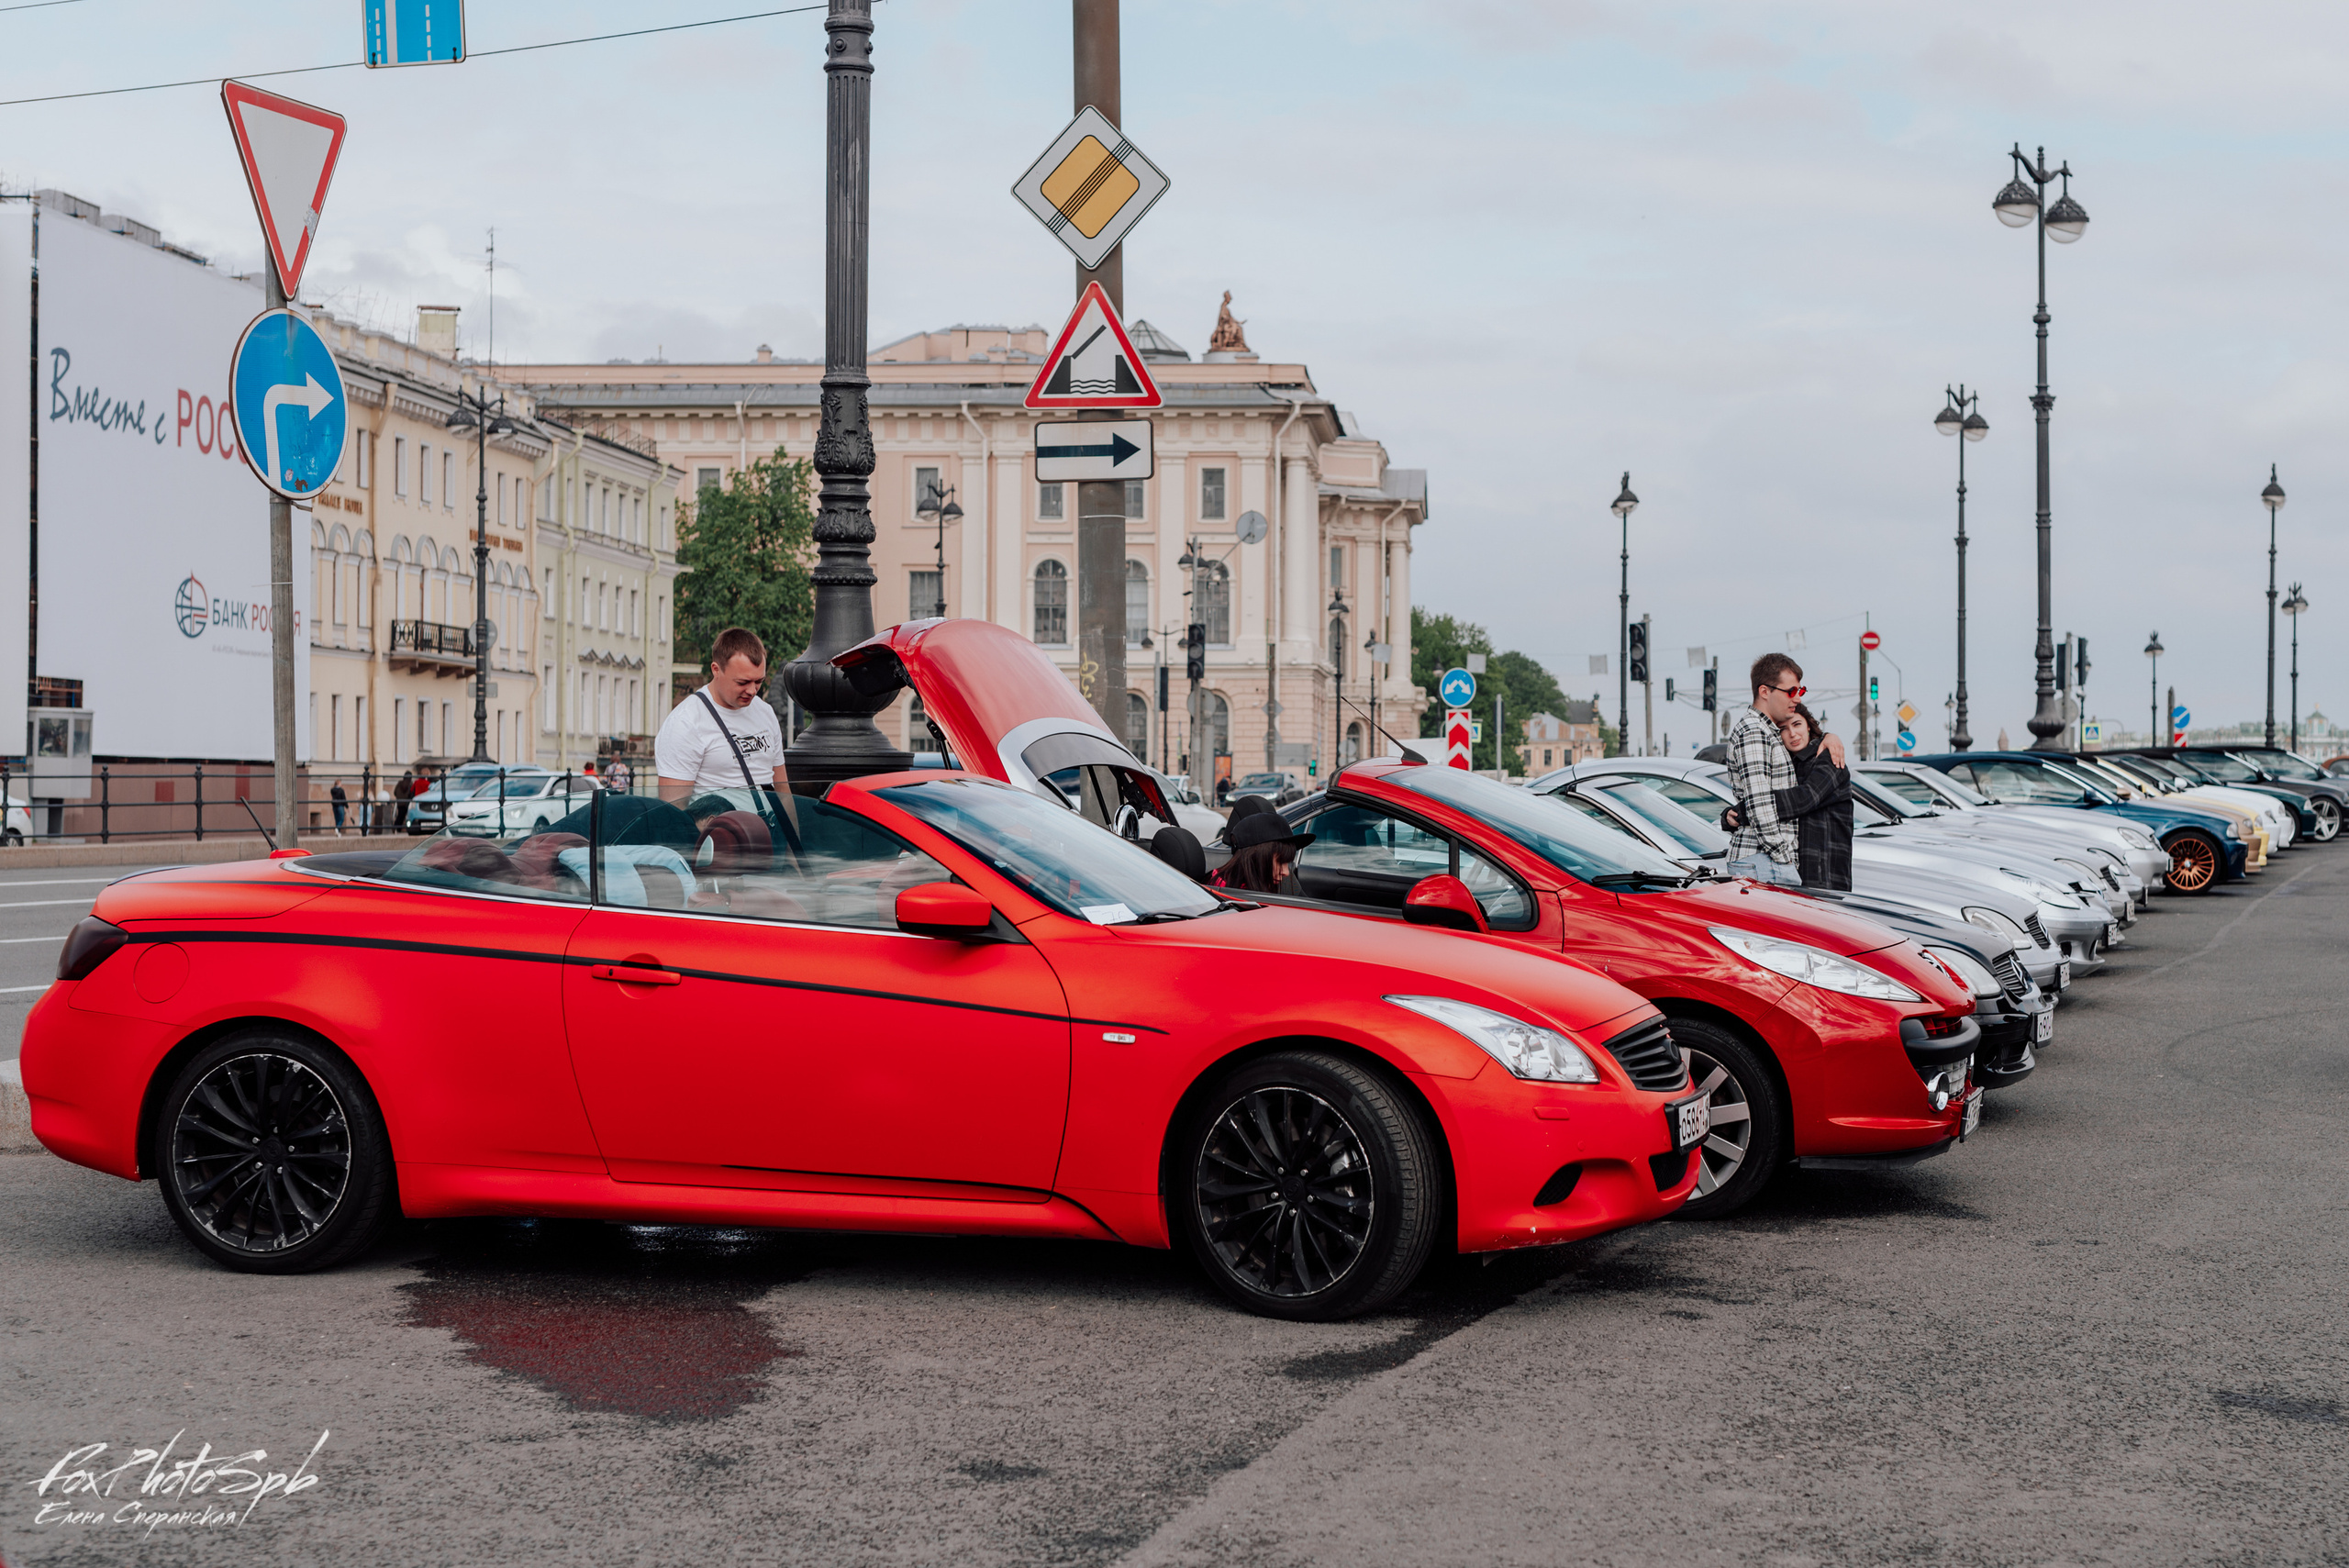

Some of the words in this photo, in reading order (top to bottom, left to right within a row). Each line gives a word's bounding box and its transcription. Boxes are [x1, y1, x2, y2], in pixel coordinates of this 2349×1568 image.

[50, 348, 146, 435] Вместе
[154, 412, 166, 444] с
[177, 388, 247, 464] РОС
[212, 598, 248, 629] БАНК
[251, 604, 301, 637] РОЯ
